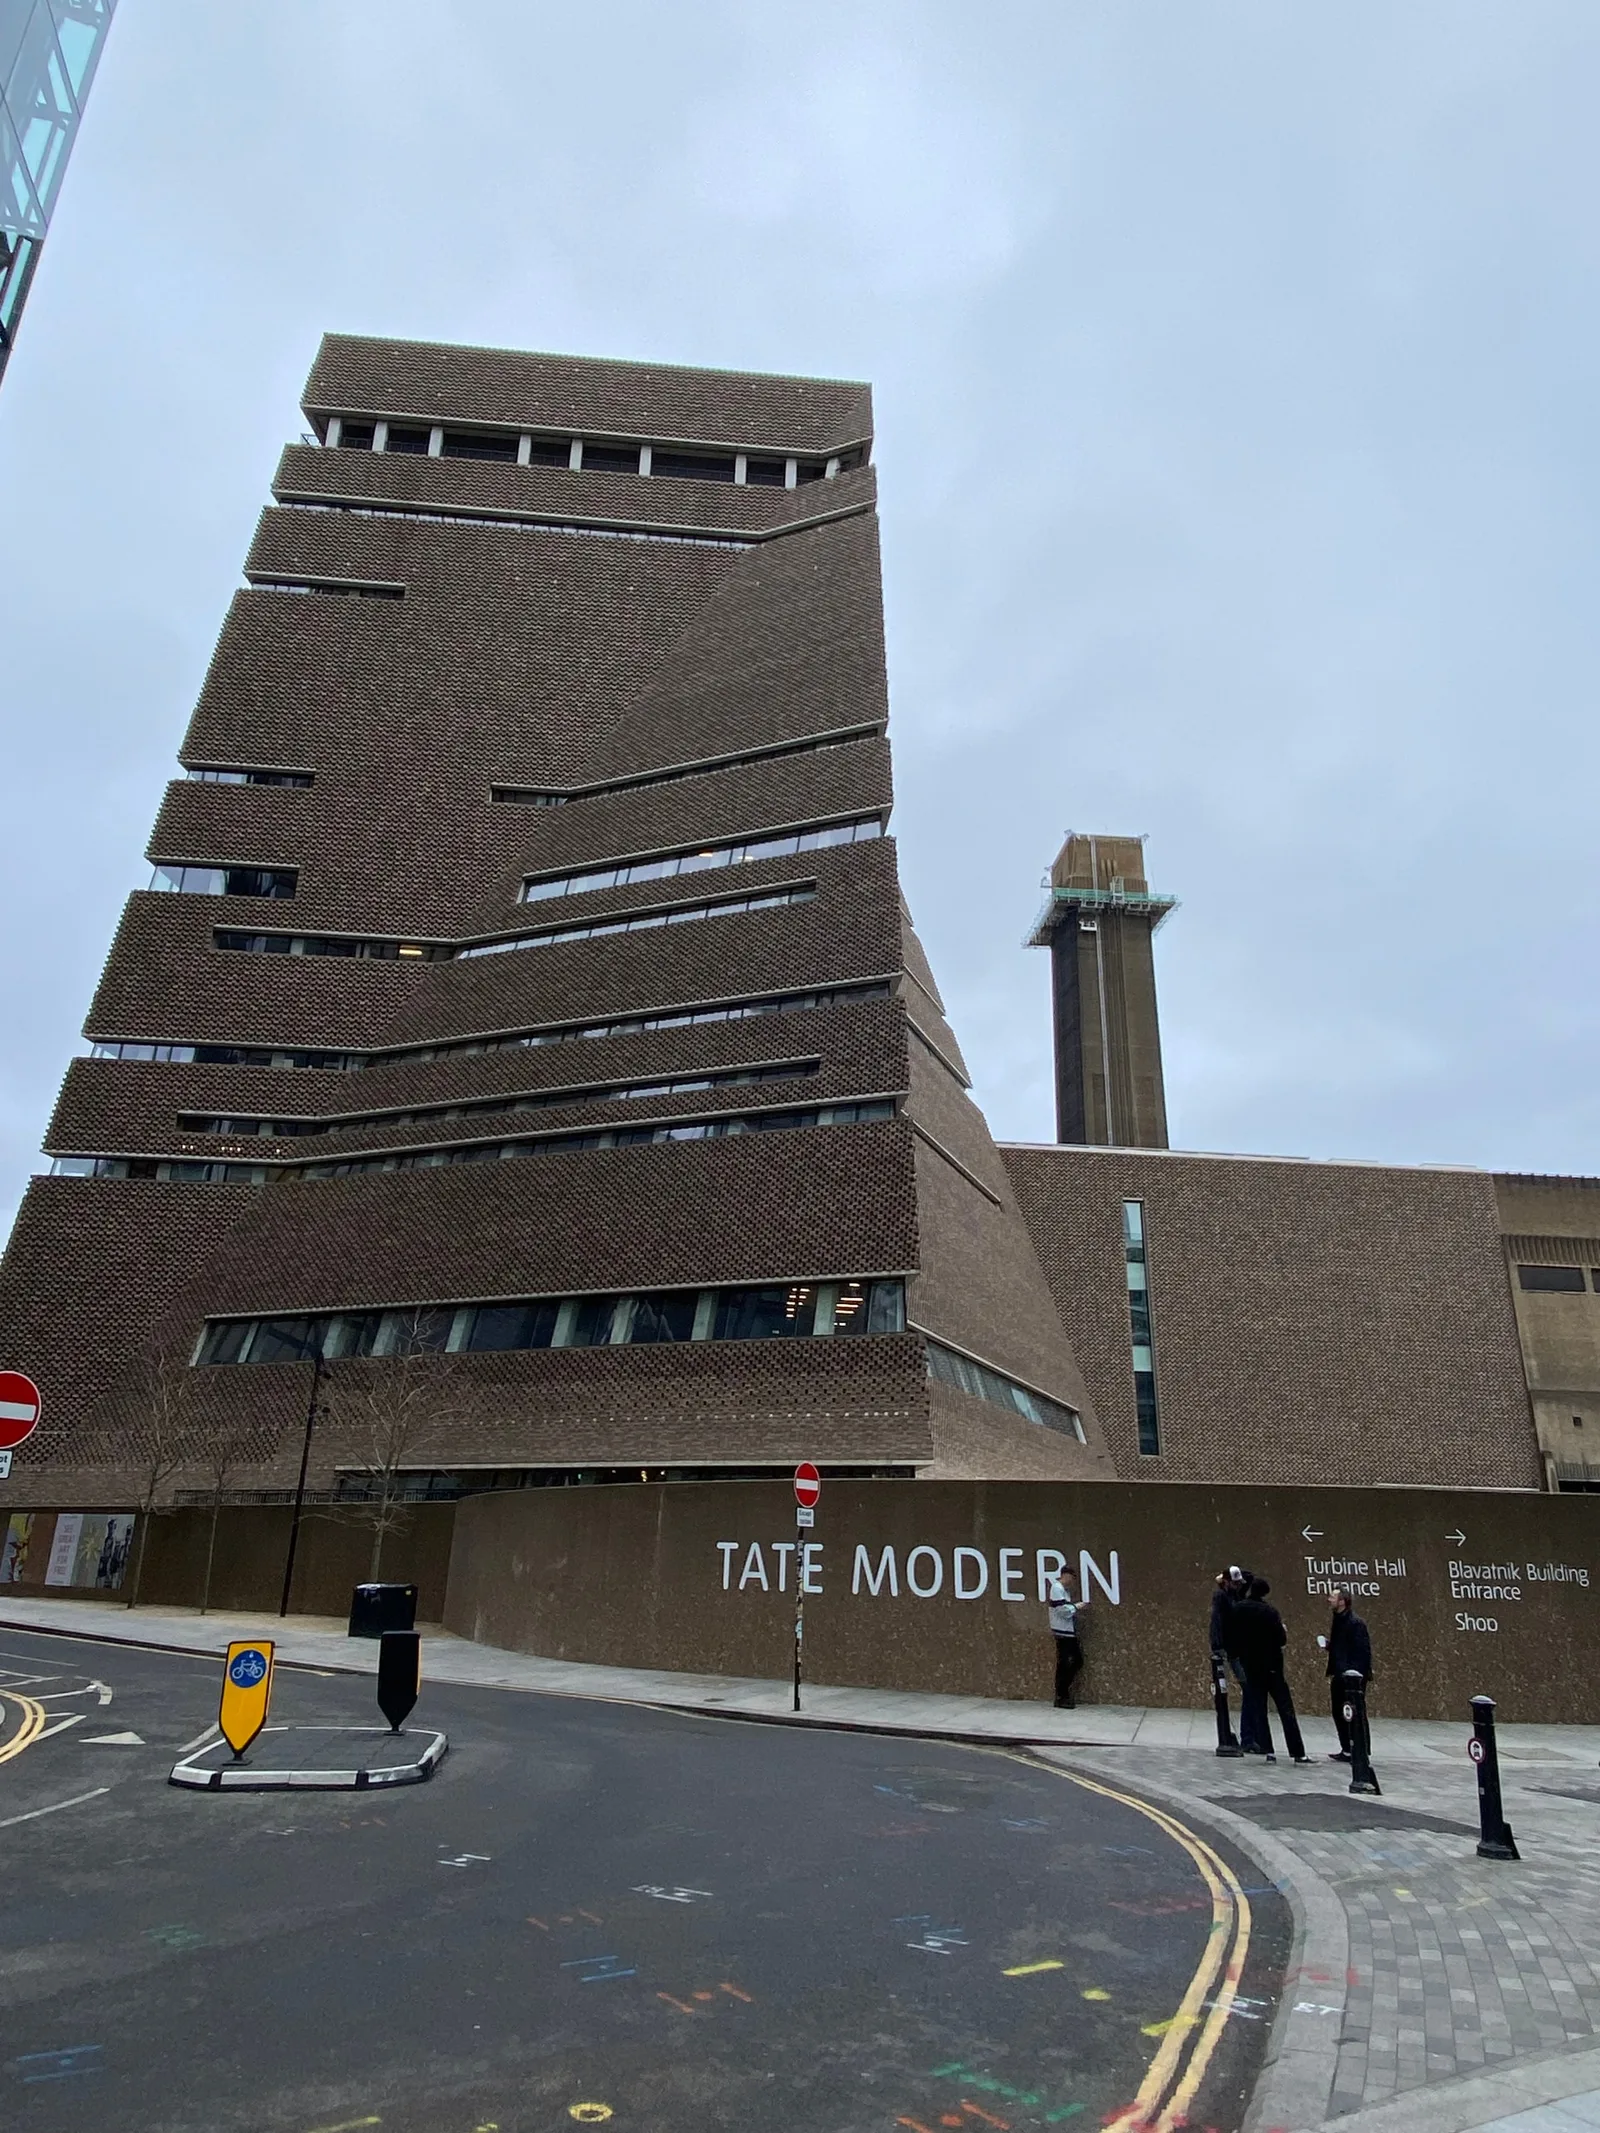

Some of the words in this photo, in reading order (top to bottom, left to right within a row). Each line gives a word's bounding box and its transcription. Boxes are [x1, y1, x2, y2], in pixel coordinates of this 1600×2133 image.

[716, 1541, 824, 1594] TATE
[851, 1544, 1121, 1605] MODERN
[1304, 1556, 1369, 1576] Turbine
[1374, 1558, 1407, 1577] Hall
[1448, 1560, 1522, 1581] Blavatnik
[1526, 1563, 1590, 1588] Building
[1451, 1581, 1522, 1600] Entrance
